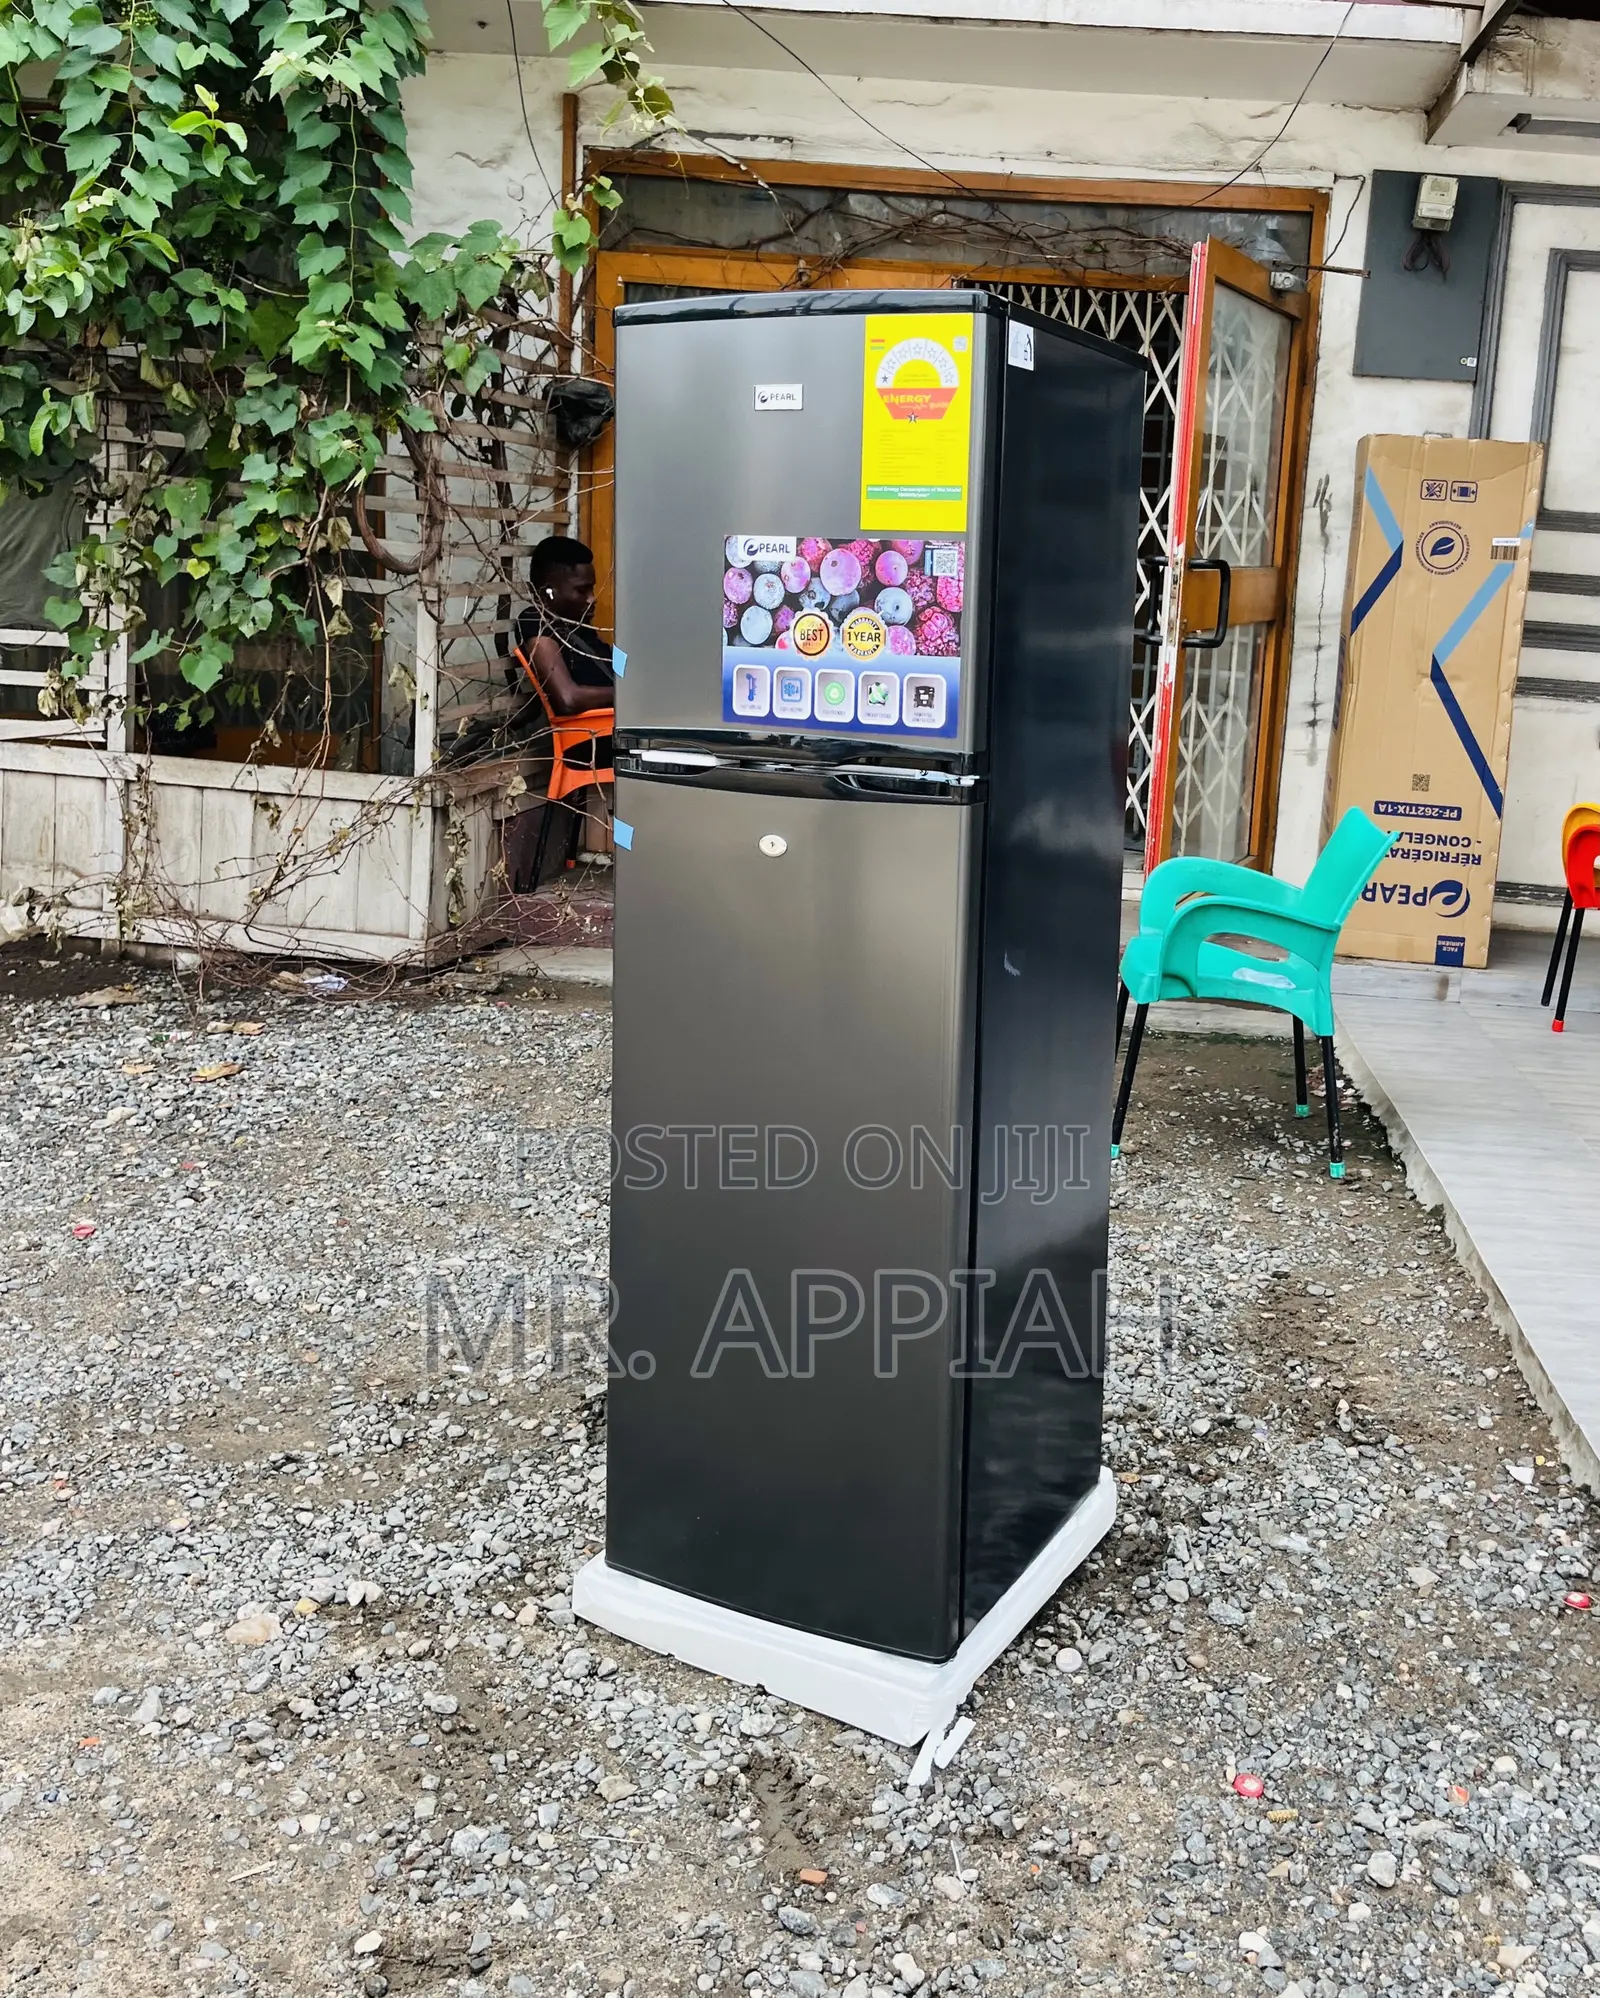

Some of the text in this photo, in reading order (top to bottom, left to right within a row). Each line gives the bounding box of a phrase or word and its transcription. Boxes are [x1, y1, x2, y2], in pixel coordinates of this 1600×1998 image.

[770, 393, 796, 401] PEARL
[882, 393, 932, 405] ENERGY
[759, 543, 791, 554] PEARL
[800, 629, 824, 641] BEST
[847, 632, 881, 642] 1 YEAR
[1378, 803, 1458, 818] PF-262TIX-1A
[1357, 882, 1428, 906] PEAR
